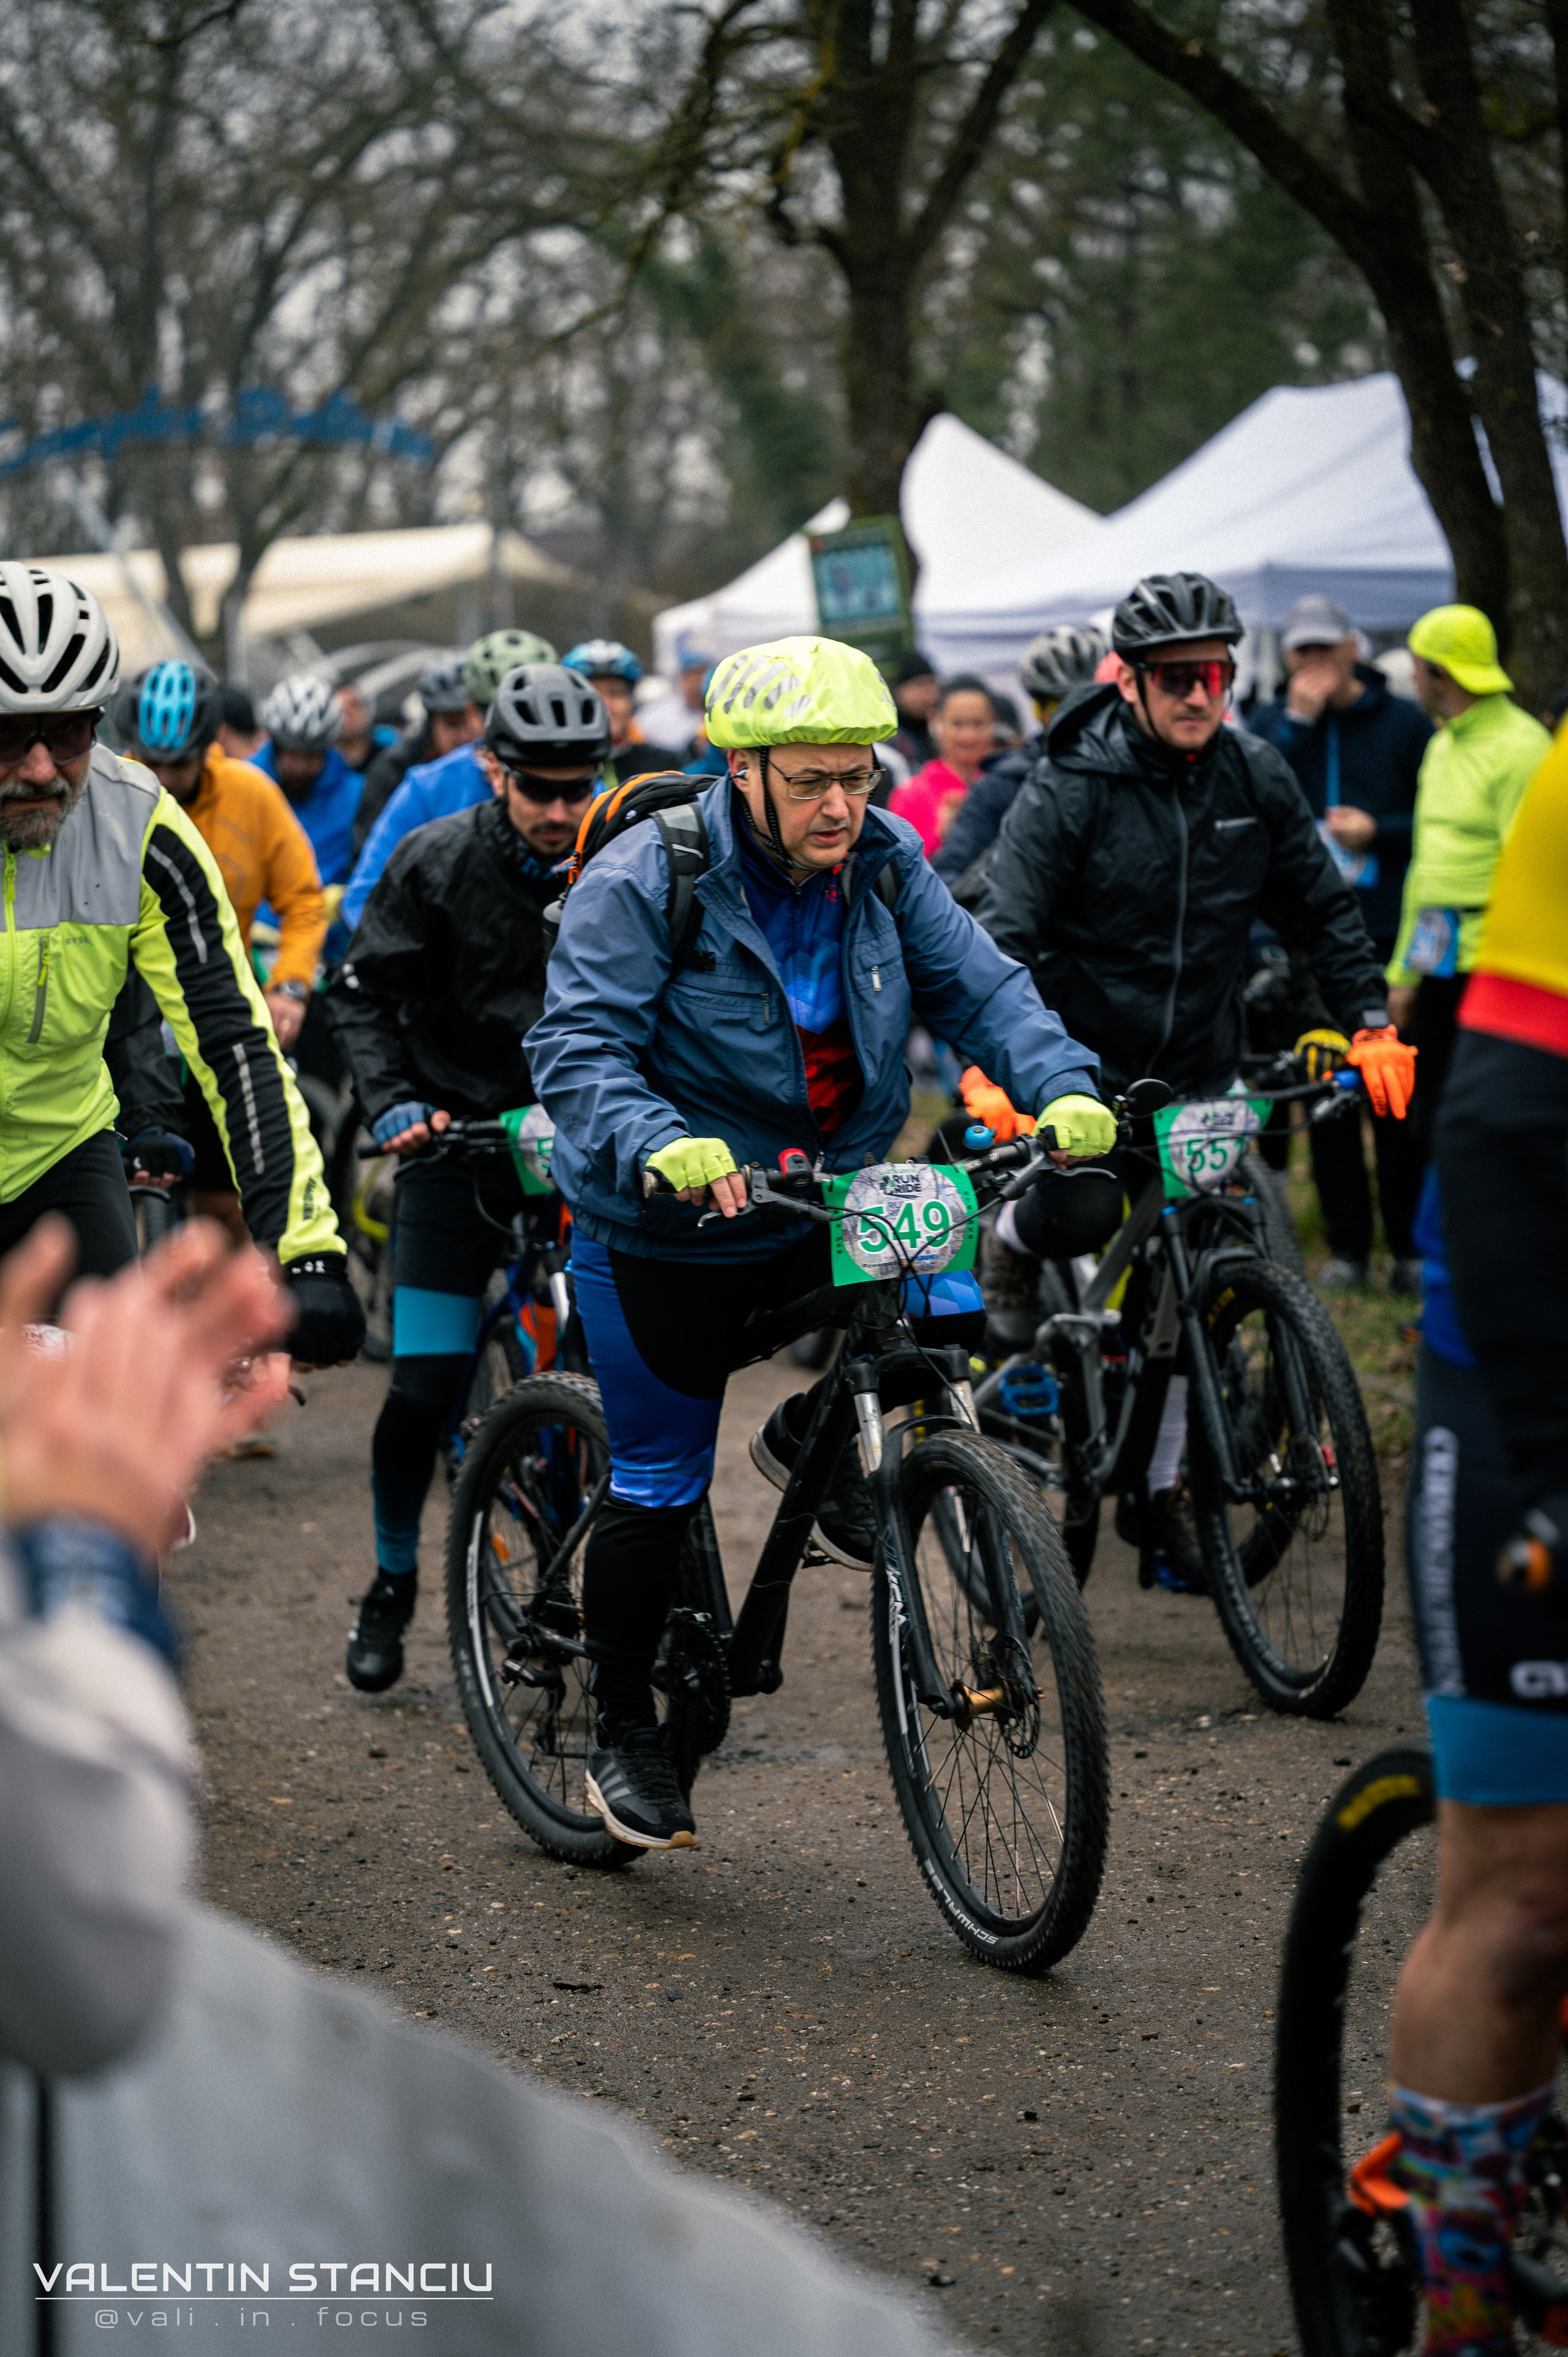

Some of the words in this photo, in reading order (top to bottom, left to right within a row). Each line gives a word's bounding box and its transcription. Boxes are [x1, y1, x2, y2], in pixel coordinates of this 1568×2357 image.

[893, 1174, 920, 1183] RUN
[895, 1183, 922, 1193] RIDE
[858, 1199, 952, 1254] 549
